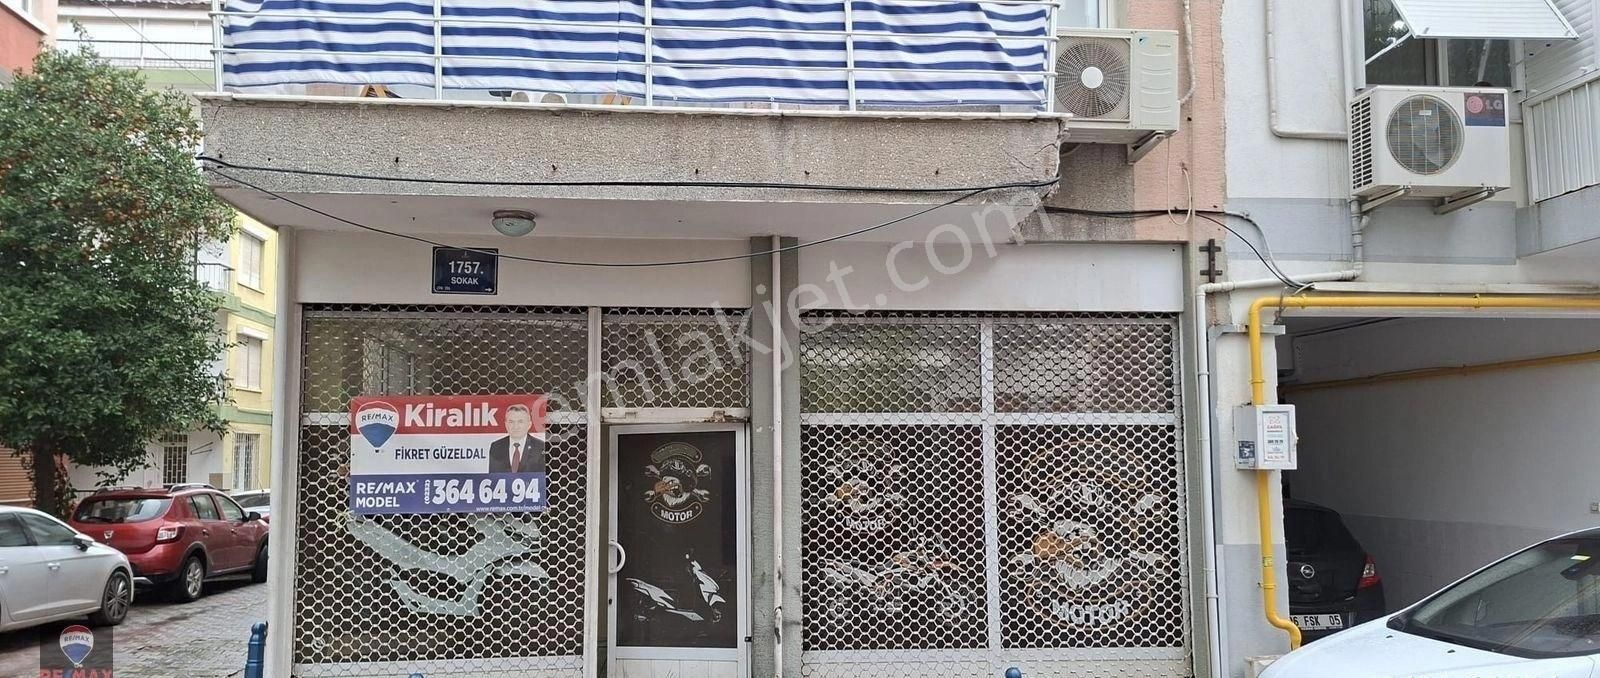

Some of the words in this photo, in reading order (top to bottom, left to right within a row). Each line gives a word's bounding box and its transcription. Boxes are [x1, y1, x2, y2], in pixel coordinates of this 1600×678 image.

[1485, 99, 1503, 110] LG
[448, 260, 484, 275] 1757.
[450, 276, 479, 285] SOKAK
[361, 412, 394, 422] RE/MAX
[405, 402, 498, 427] Kiralık
[394, 446, 430, 460] FİKRET
[433, 445, 487, 460] GÜZELDAL
[356, 481, 416, 495] RE/MAX
[432, 479, 474, 505] 364
[478, 478, 507, 504] 64
[511, 478, 541, 503] 94
[355, 496, 399, 508] MODEL
[660, 509, 693, 522] MOTOR
[1051, 599, 1130, 626] MOTOR
